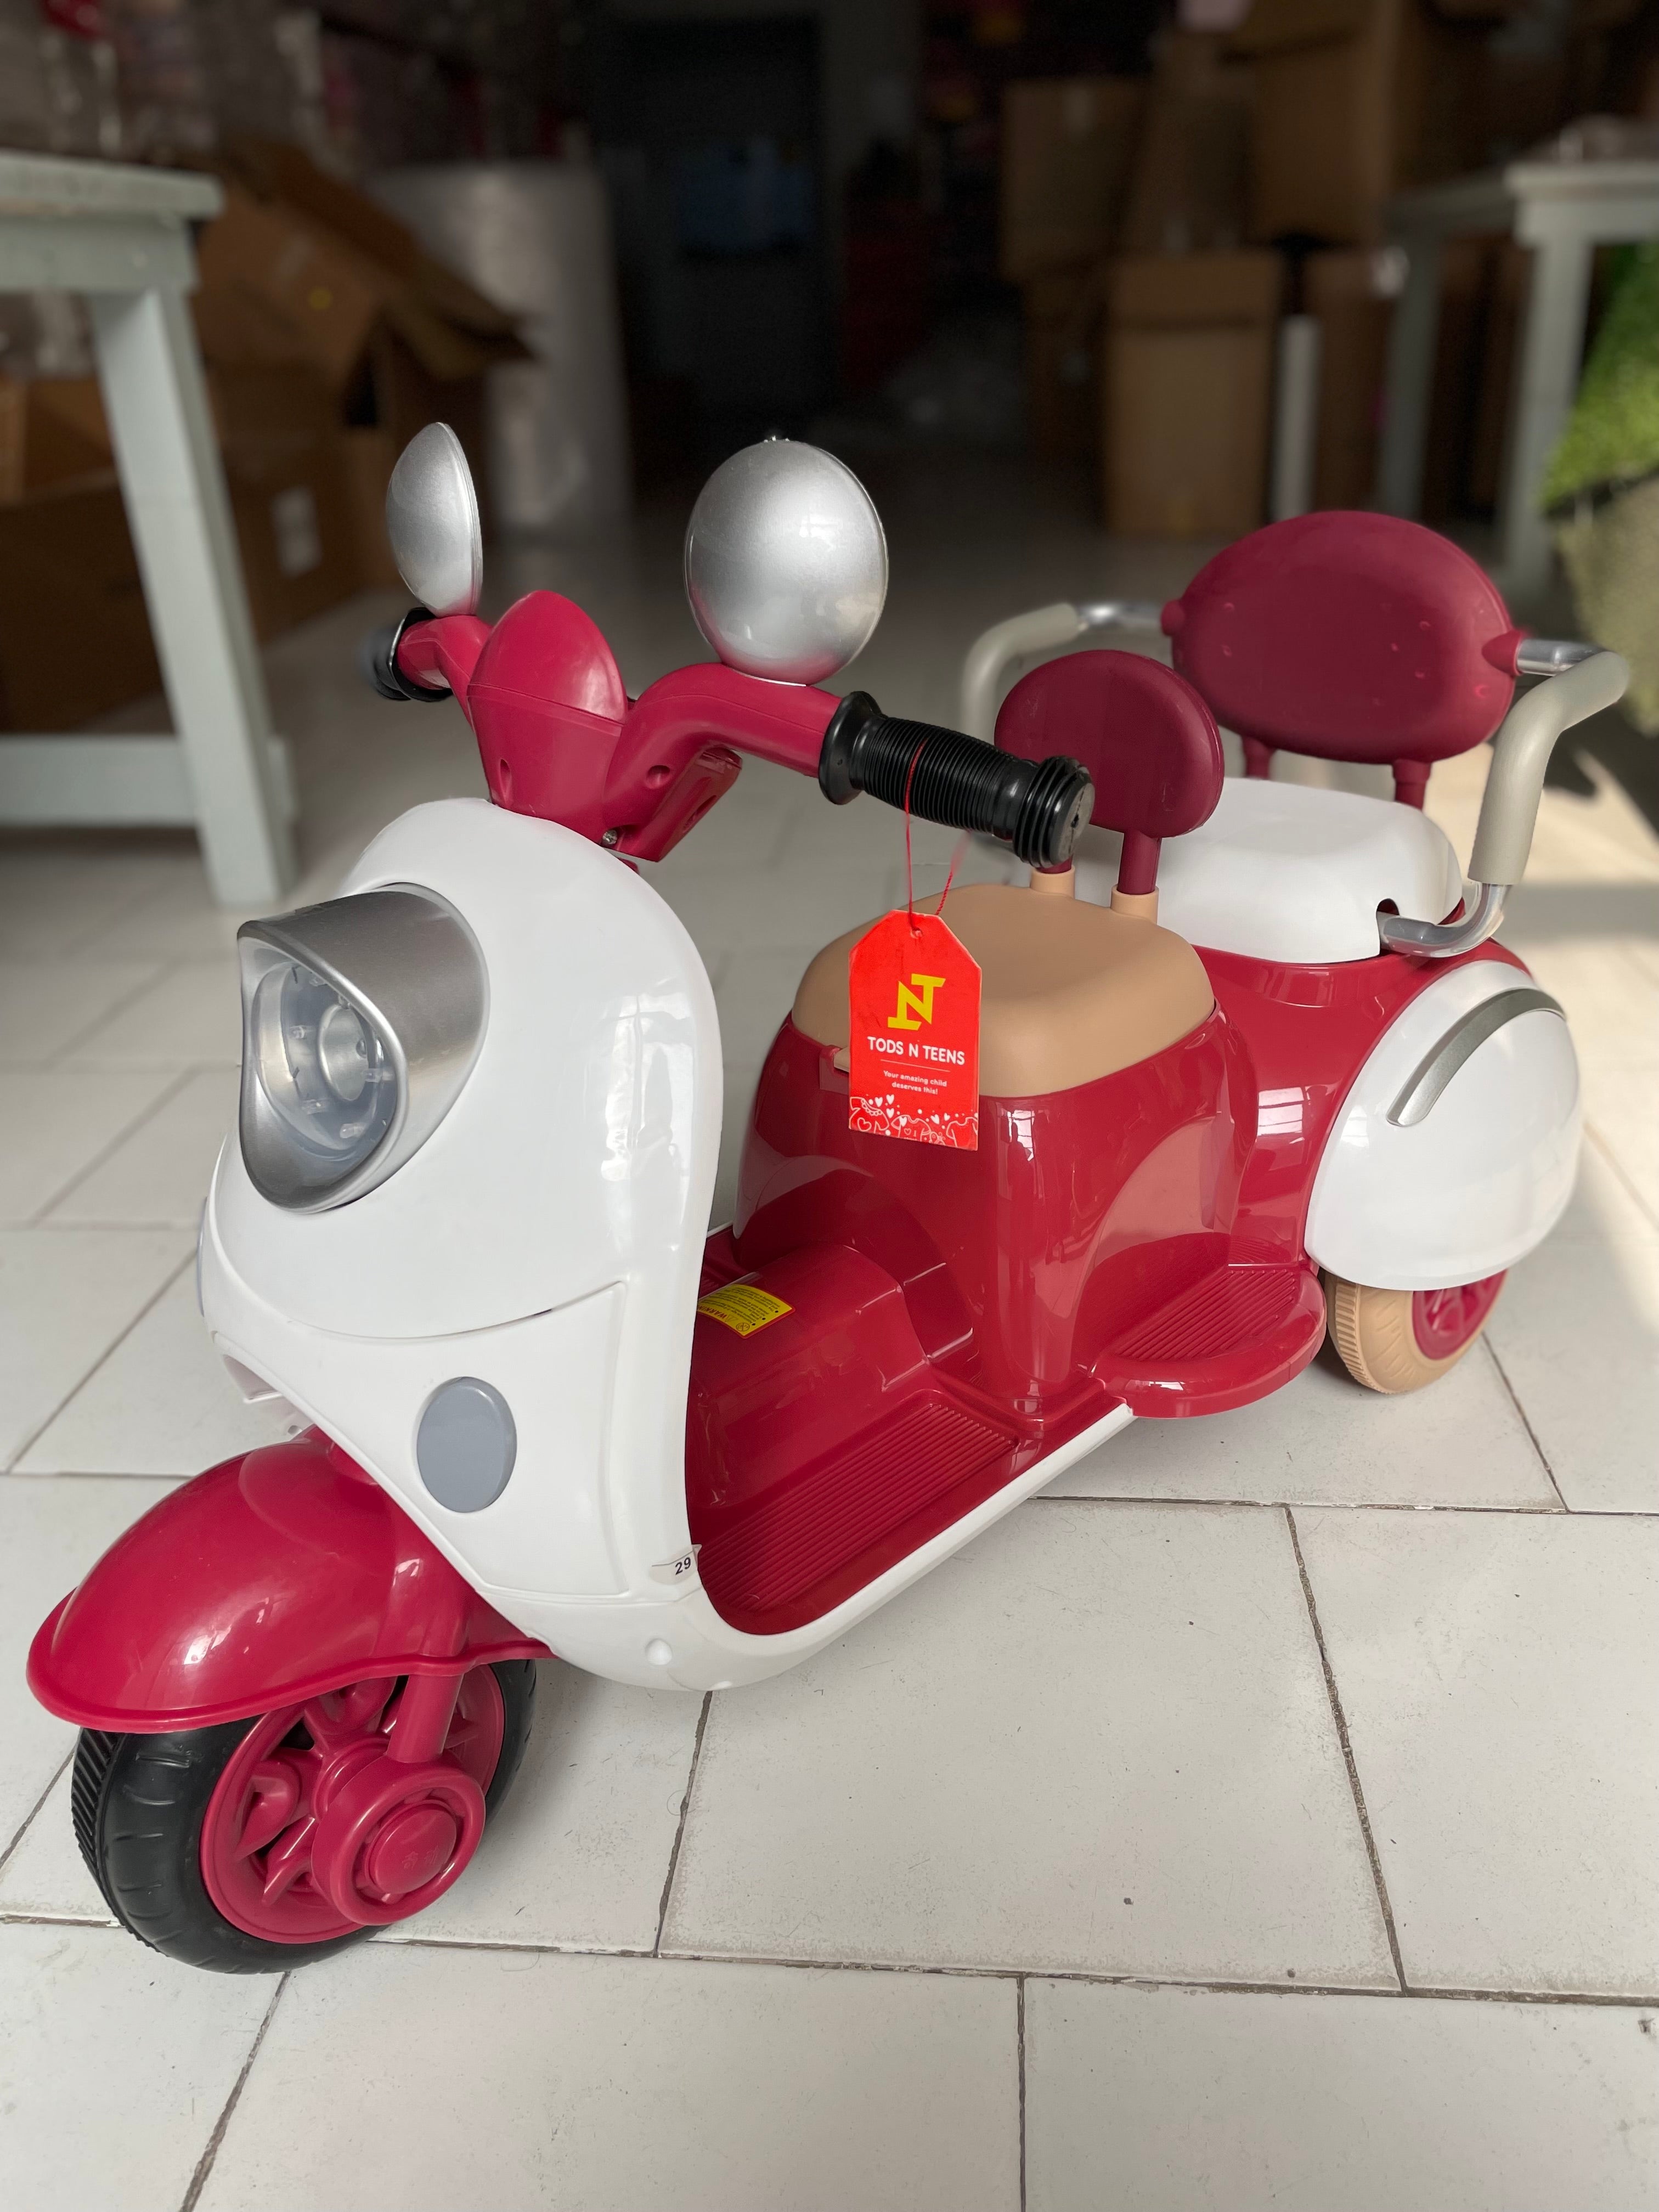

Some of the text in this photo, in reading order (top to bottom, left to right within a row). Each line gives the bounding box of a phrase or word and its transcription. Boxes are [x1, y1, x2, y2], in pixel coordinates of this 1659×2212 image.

[867, 1036, 965, 1065] TODS N TEENS
[883, 1070, 947, 1087] Your amazing child
[891, 1081, 938, 1095] deserves this!
[697, 1306, 727, 1319] WARNIN
[675, 1557, 691, 1576] 29
